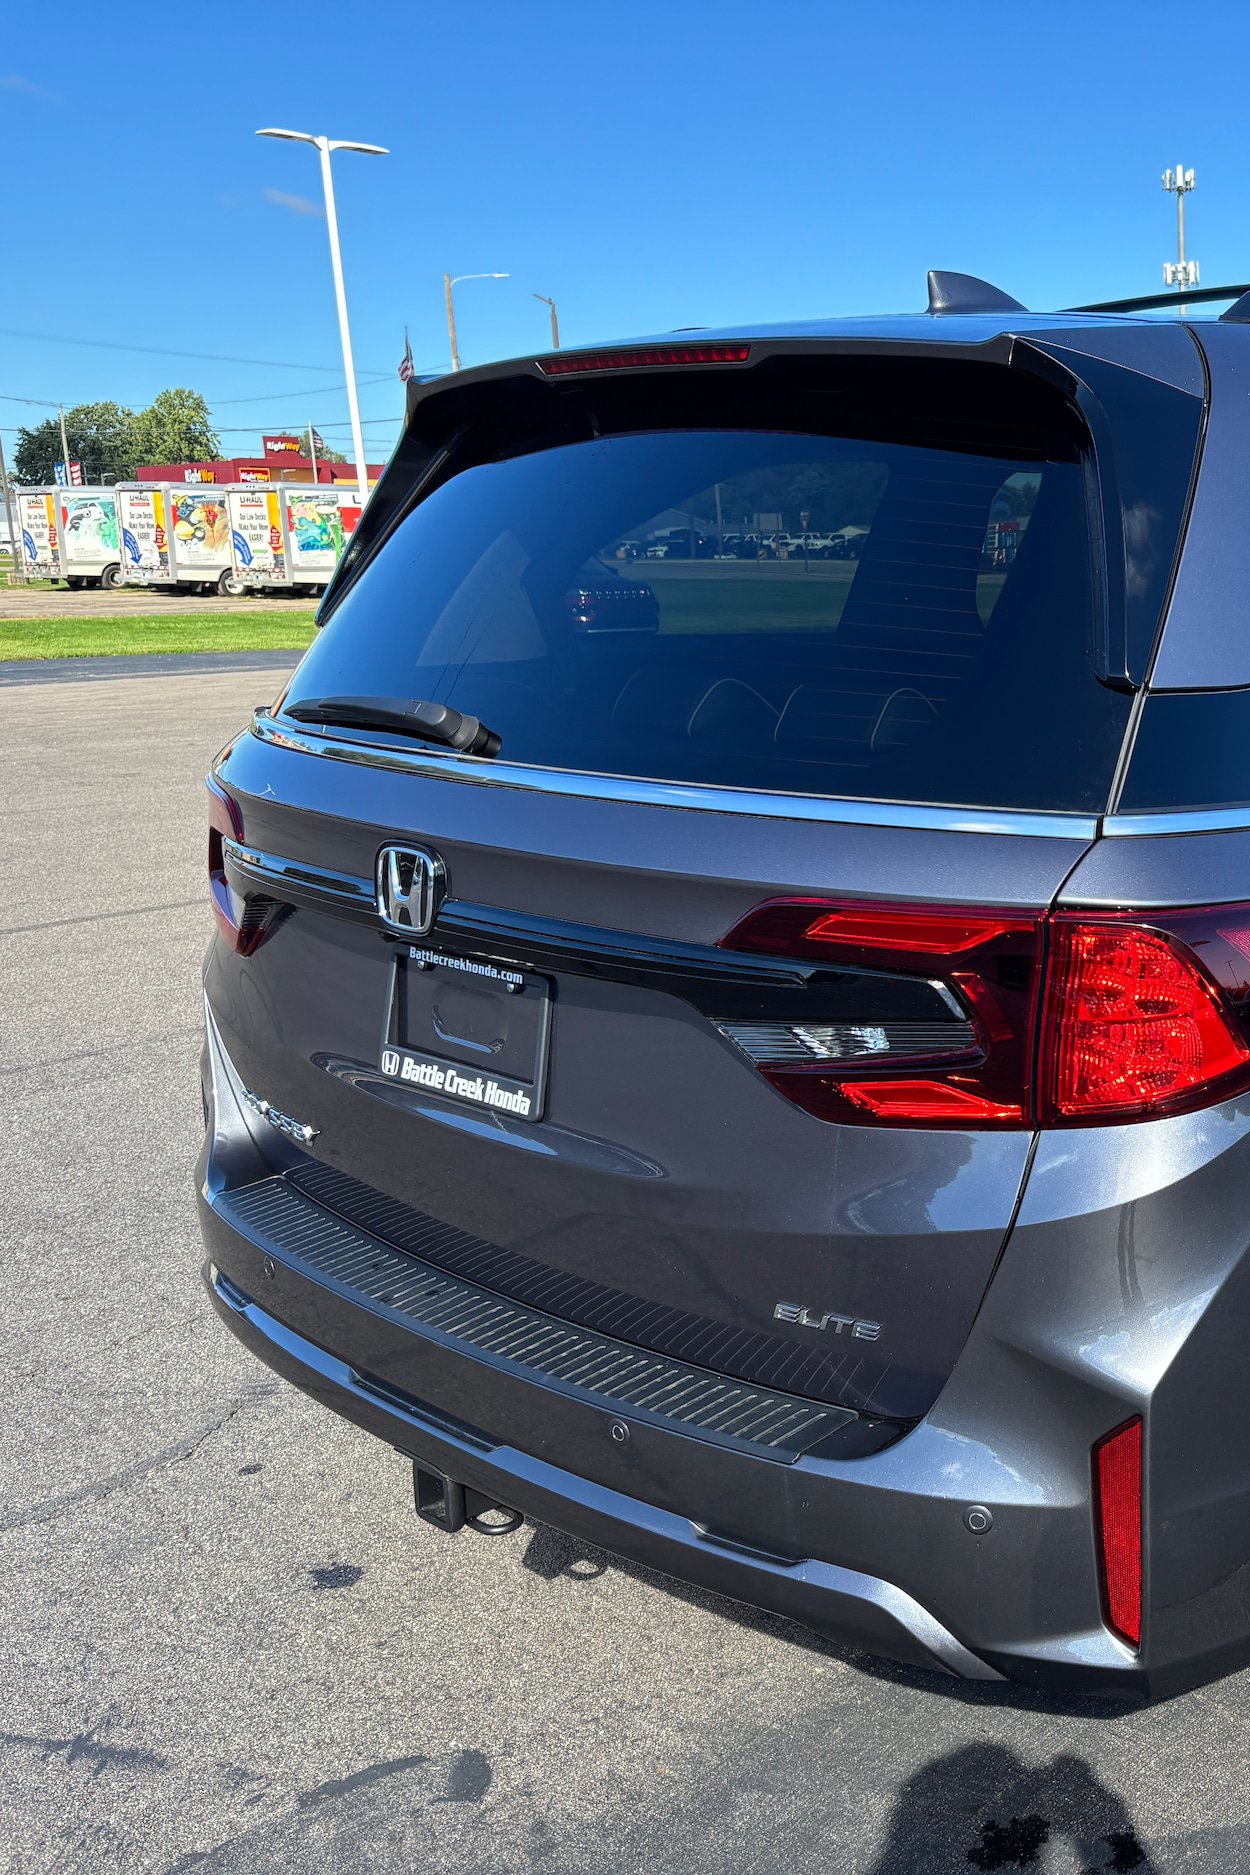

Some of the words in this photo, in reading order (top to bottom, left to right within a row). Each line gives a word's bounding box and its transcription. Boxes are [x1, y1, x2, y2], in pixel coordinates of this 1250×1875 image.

[266, 441, 301, 452] RightWay
[409, 946, 523, 985] Battlecreekhonda.com
[401, 1057, 445, 1090] Battle
[444, 1070, 486, 1102] Creek
[484, 1081, 532, 1116] Honda
[773, 1300, 882, 1342] ELITE
